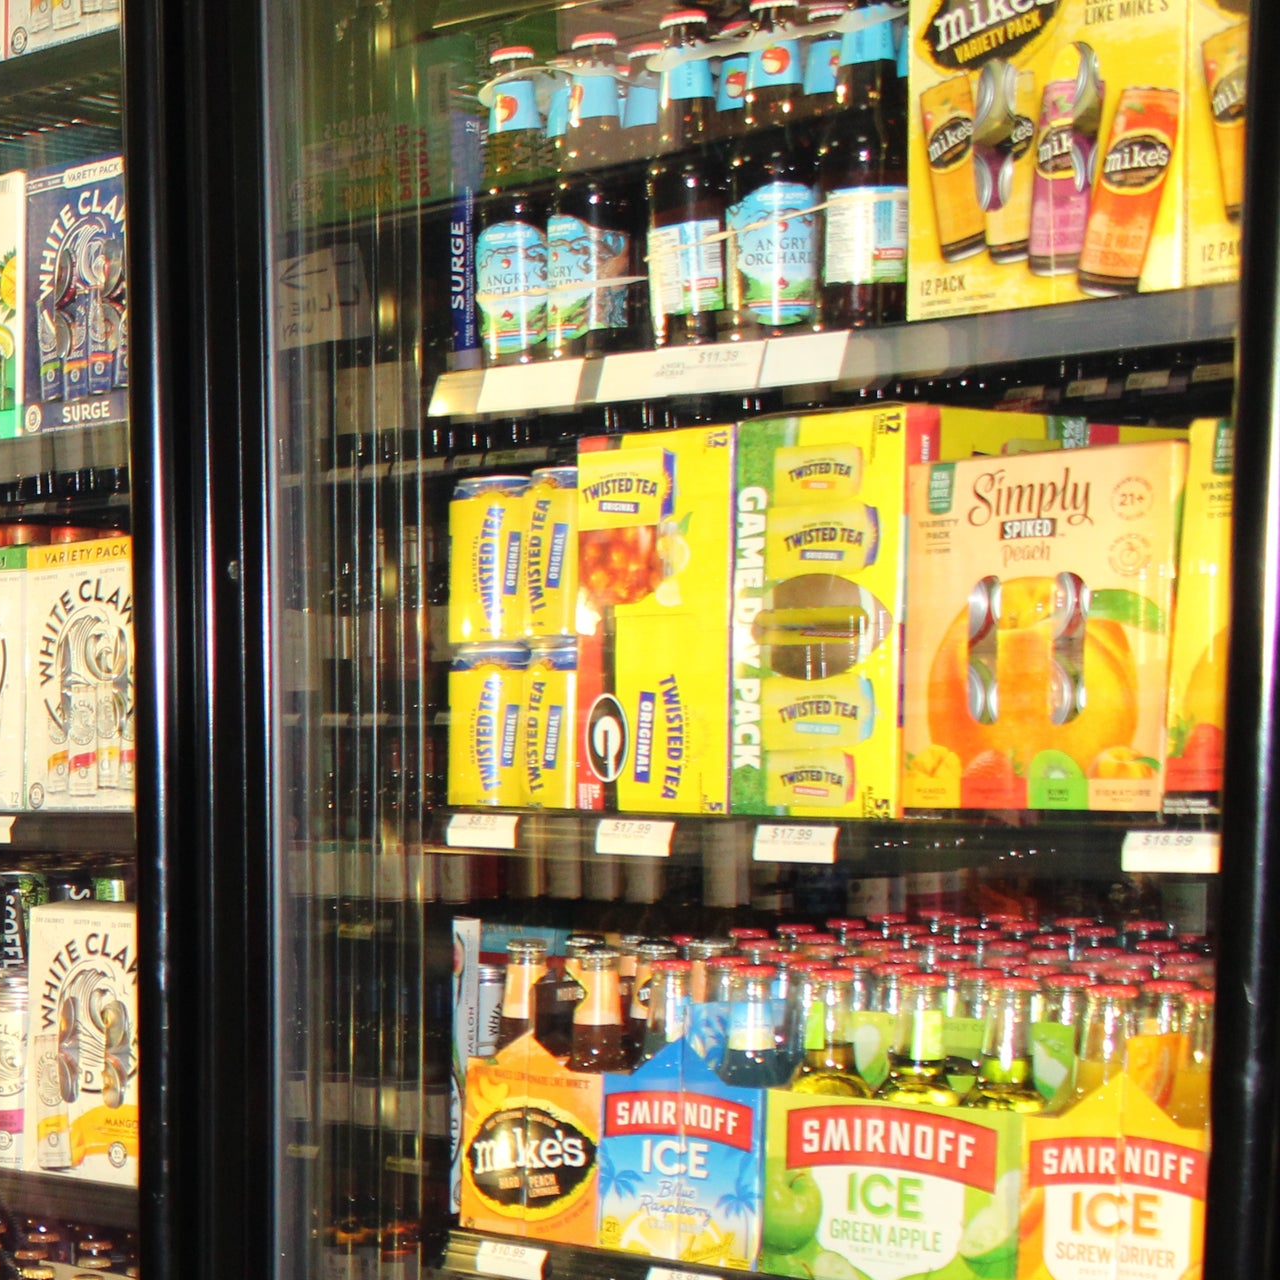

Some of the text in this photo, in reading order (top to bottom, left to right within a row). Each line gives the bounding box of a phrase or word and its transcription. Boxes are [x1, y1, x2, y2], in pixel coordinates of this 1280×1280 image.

[1084, 9, 1116, 26] LIKE
[954, 16, 1041, 64] VARIETY PACK
[1105, 146, 1169, 174] mike's
[756, 237, 808, 252] ANGRY
[450, 221, 466, 311] SURGE
[920, 278, 966, 295] 12 PACK
[63, 402, 110, 423] SURGE
[582, 479, 659, 502] TWISTED TEA
[967, 466, 1093, 527] Simply
[1118, 492, 1145, 506] 21+
[1001, 518, 1054, 538] SPIKED
[45, 544, 127, 564] VARIETY PACK
[504, 532, 521, 595] ORIGINAL
[547, 523, 568, 588] ORIGINAL
[1001, 541, 1051, 567] peach
[734, 679, 762, 770] PACK
[616, 1101, 739, 1135] SMIRNOFF
[642, 1139, 709, 1179] ICE
[801, 1119, 976, 1170] SMIRNOFF
[529, 1173, 557, 1188] PEACH
[1042, 1148, 1195, 1184] SMIRNOFF
[846, 1173, 922, 1220] ICE
[1071, 1192, 1162, 1237] ICE
[830, 1218, 943, 1254] GREEN APPLE
